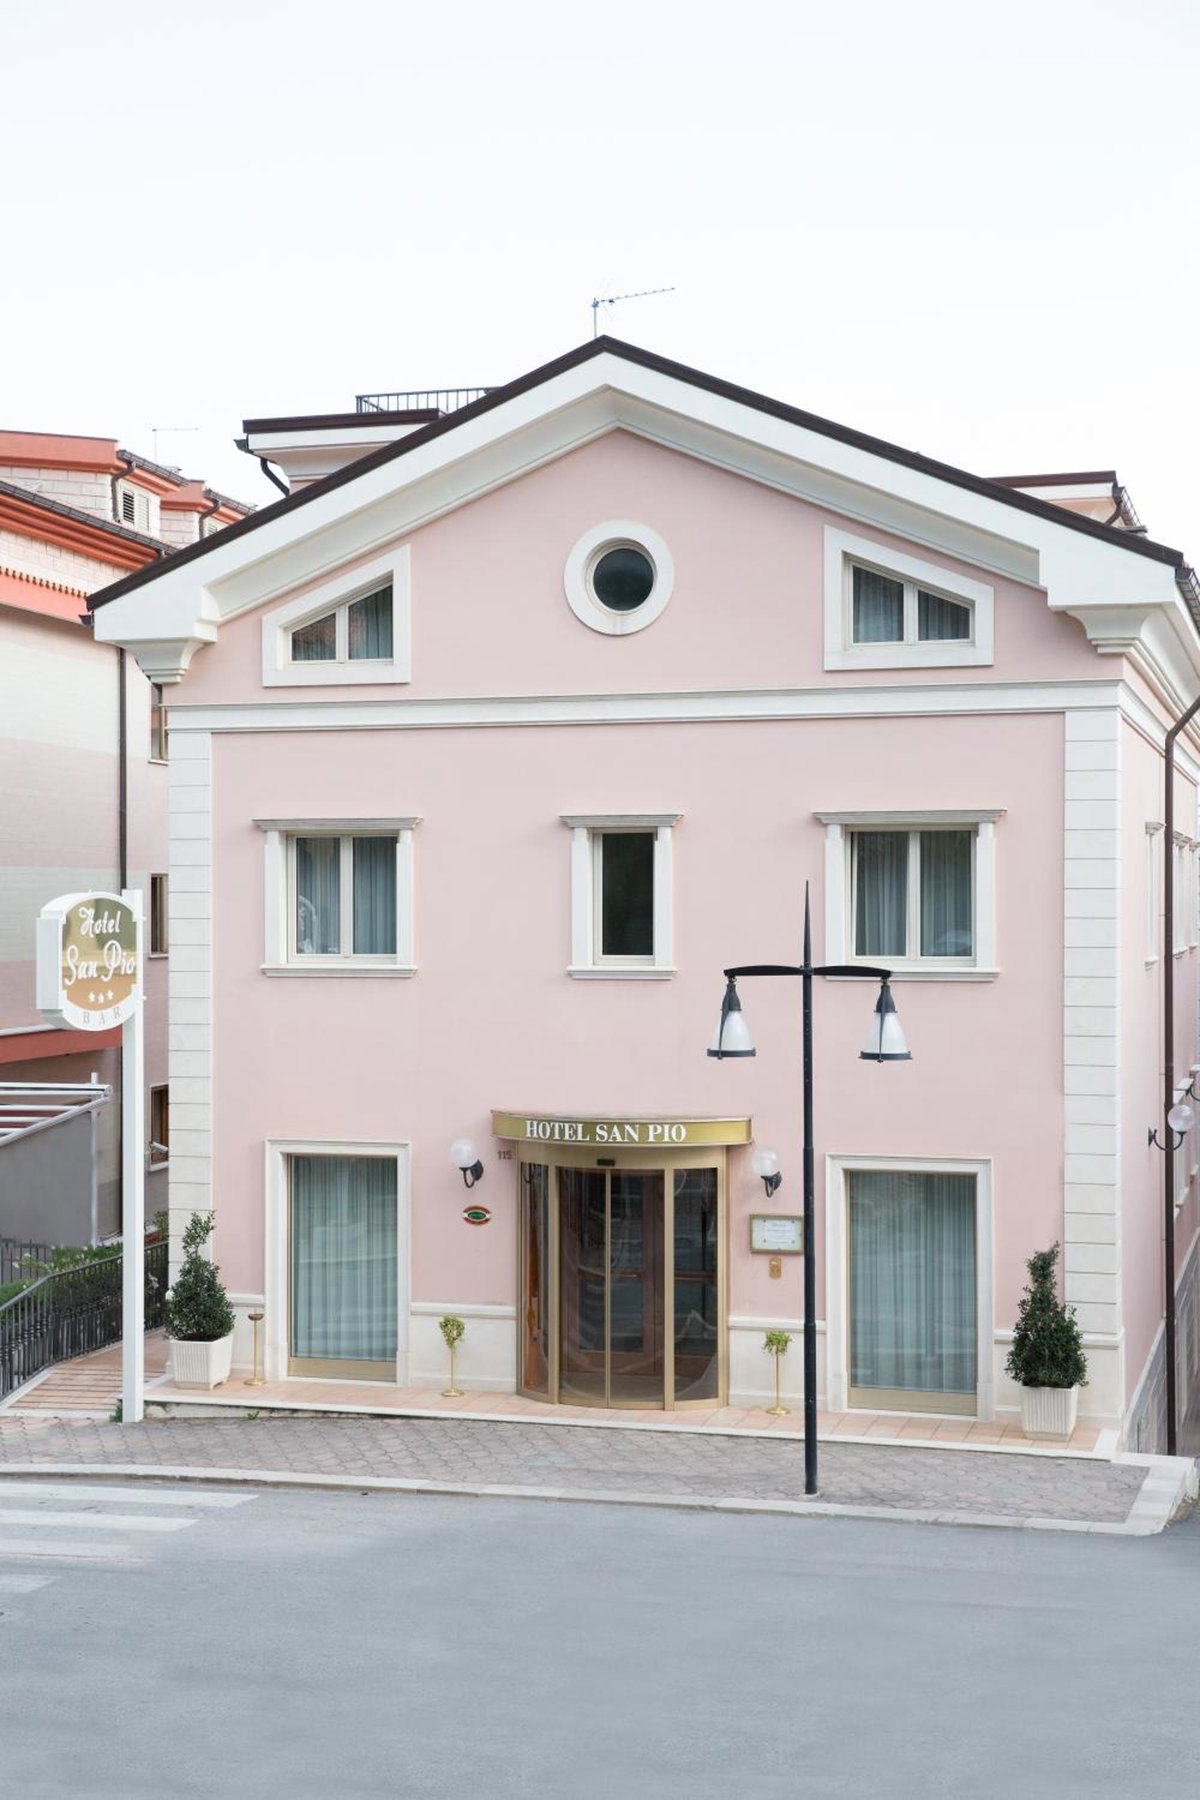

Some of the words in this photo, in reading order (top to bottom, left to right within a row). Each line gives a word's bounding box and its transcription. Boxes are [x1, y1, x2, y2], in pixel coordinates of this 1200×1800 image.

[78, 906, 121, 938] Hotel
[64, 944, 98, 986] San
[101, 940, 135, 982] Pio
[83, 1007, 122, 1025] BAR
[525, 1120, 589, 1141] HOTEL
[596, 1124, 640, 1142] SAN
[648, 1124, 687, 1142] PIO
